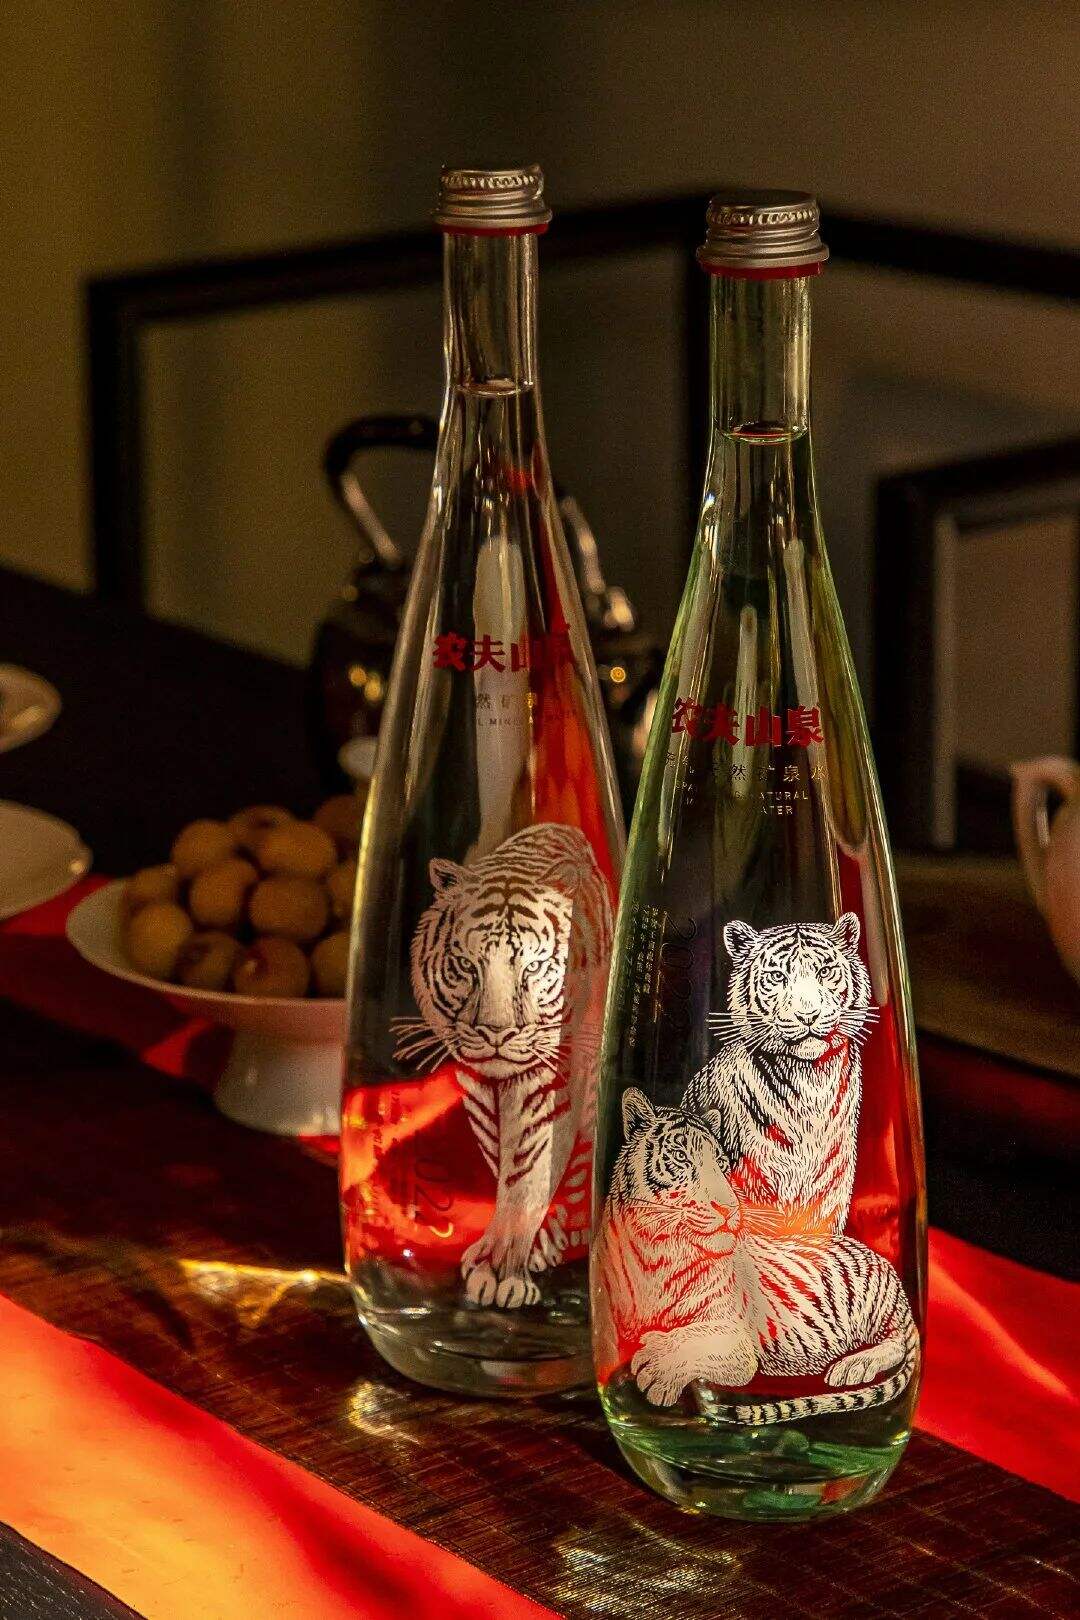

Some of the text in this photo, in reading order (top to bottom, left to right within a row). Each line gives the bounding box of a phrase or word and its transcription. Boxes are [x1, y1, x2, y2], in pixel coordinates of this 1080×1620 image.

[433, 628, 571, 673] 农夫山
[671, 697, 824, 748] 农夫山泉
[754, 790, 809, 801] ATURAL
[754, 805, 794, 816] ATER
